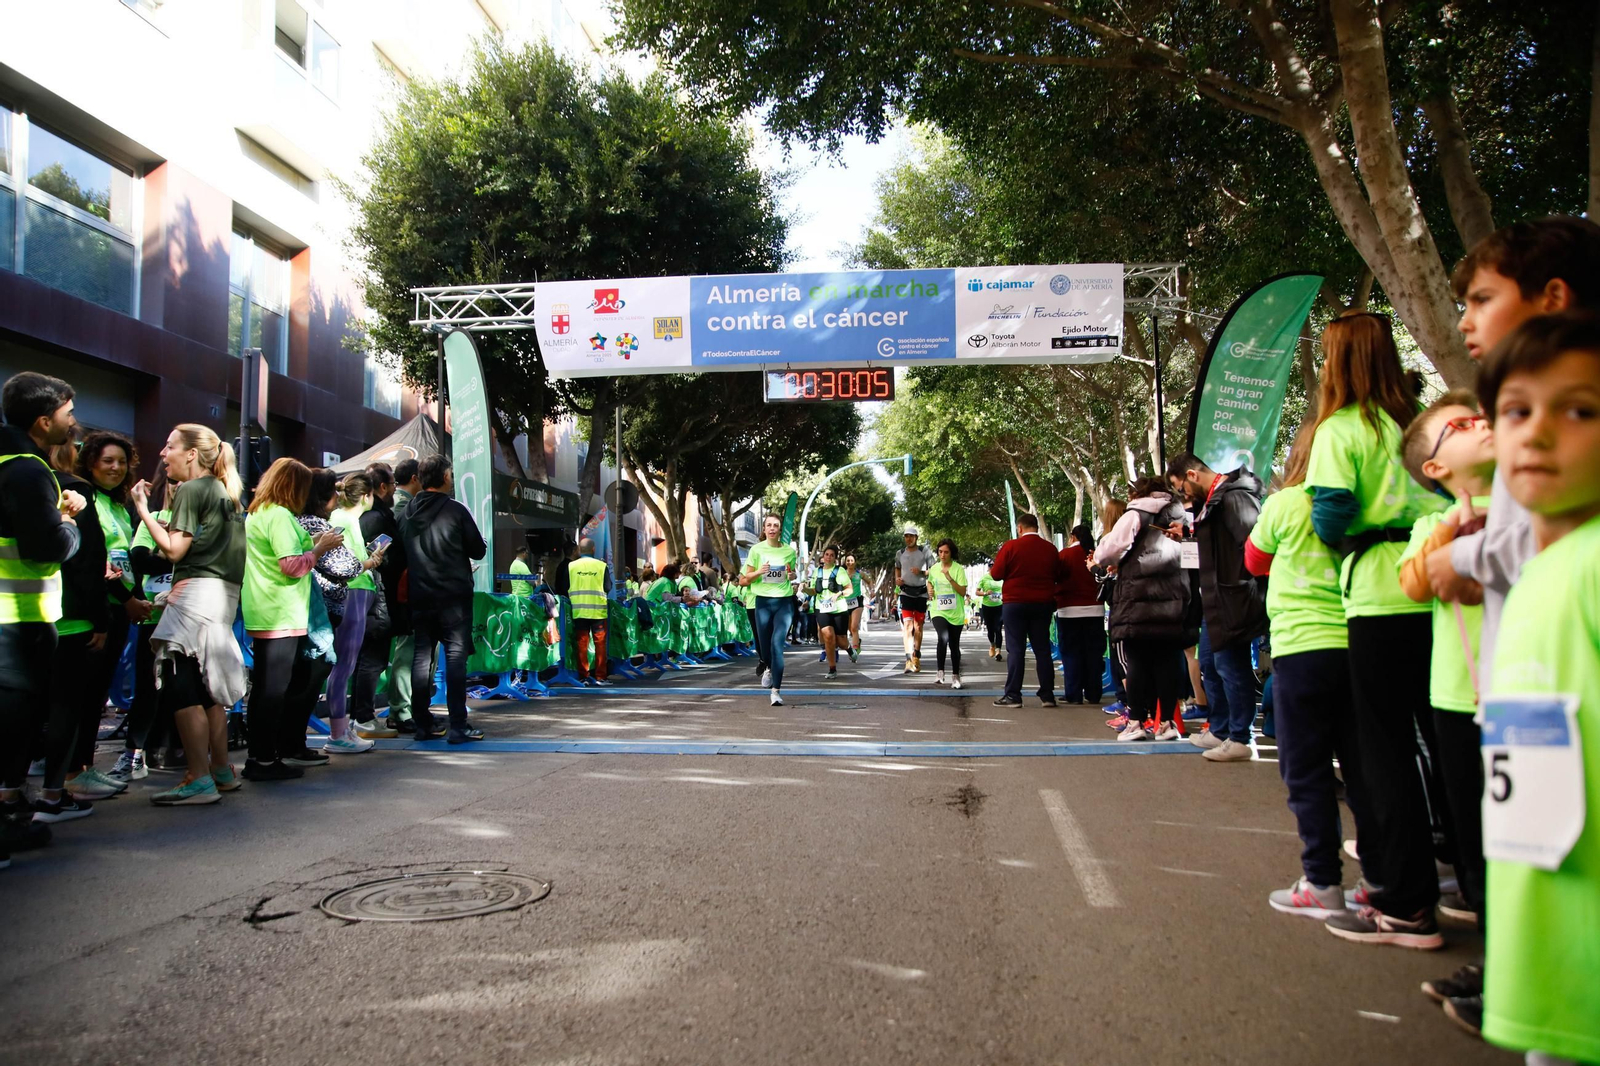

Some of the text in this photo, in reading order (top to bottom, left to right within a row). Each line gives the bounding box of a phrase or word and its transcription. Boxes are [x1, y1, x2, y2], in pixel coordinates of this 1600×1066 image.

[707, 278, 939, 304] Almería en marcha
[986, 279, 1035, 292] cajamar
[1033, 306, 1089, 318] Fundación
[656, 319, 679, 328] SOLAN
[707, 307, 908, 331] contra el cáncer
[1062, 325, 1108, 335] Ejido Motor
[543, 338, 578, 347] ALMERÍA
[991, 333, 1015, 341] Toyota
[702, 349, 780, 358] #TodosContraElCáncer
[1224, 370, 1276, 388] Tenemos
[1220, 385, 1263, 399] un gran
[1216, 398, 1259, 411] camino
[1213, 410, 1234, 420] por
[1212, 421, 1257, 437] delante
[766, 570, 782, 578] 206
[939, 598, 953, 606] 303
